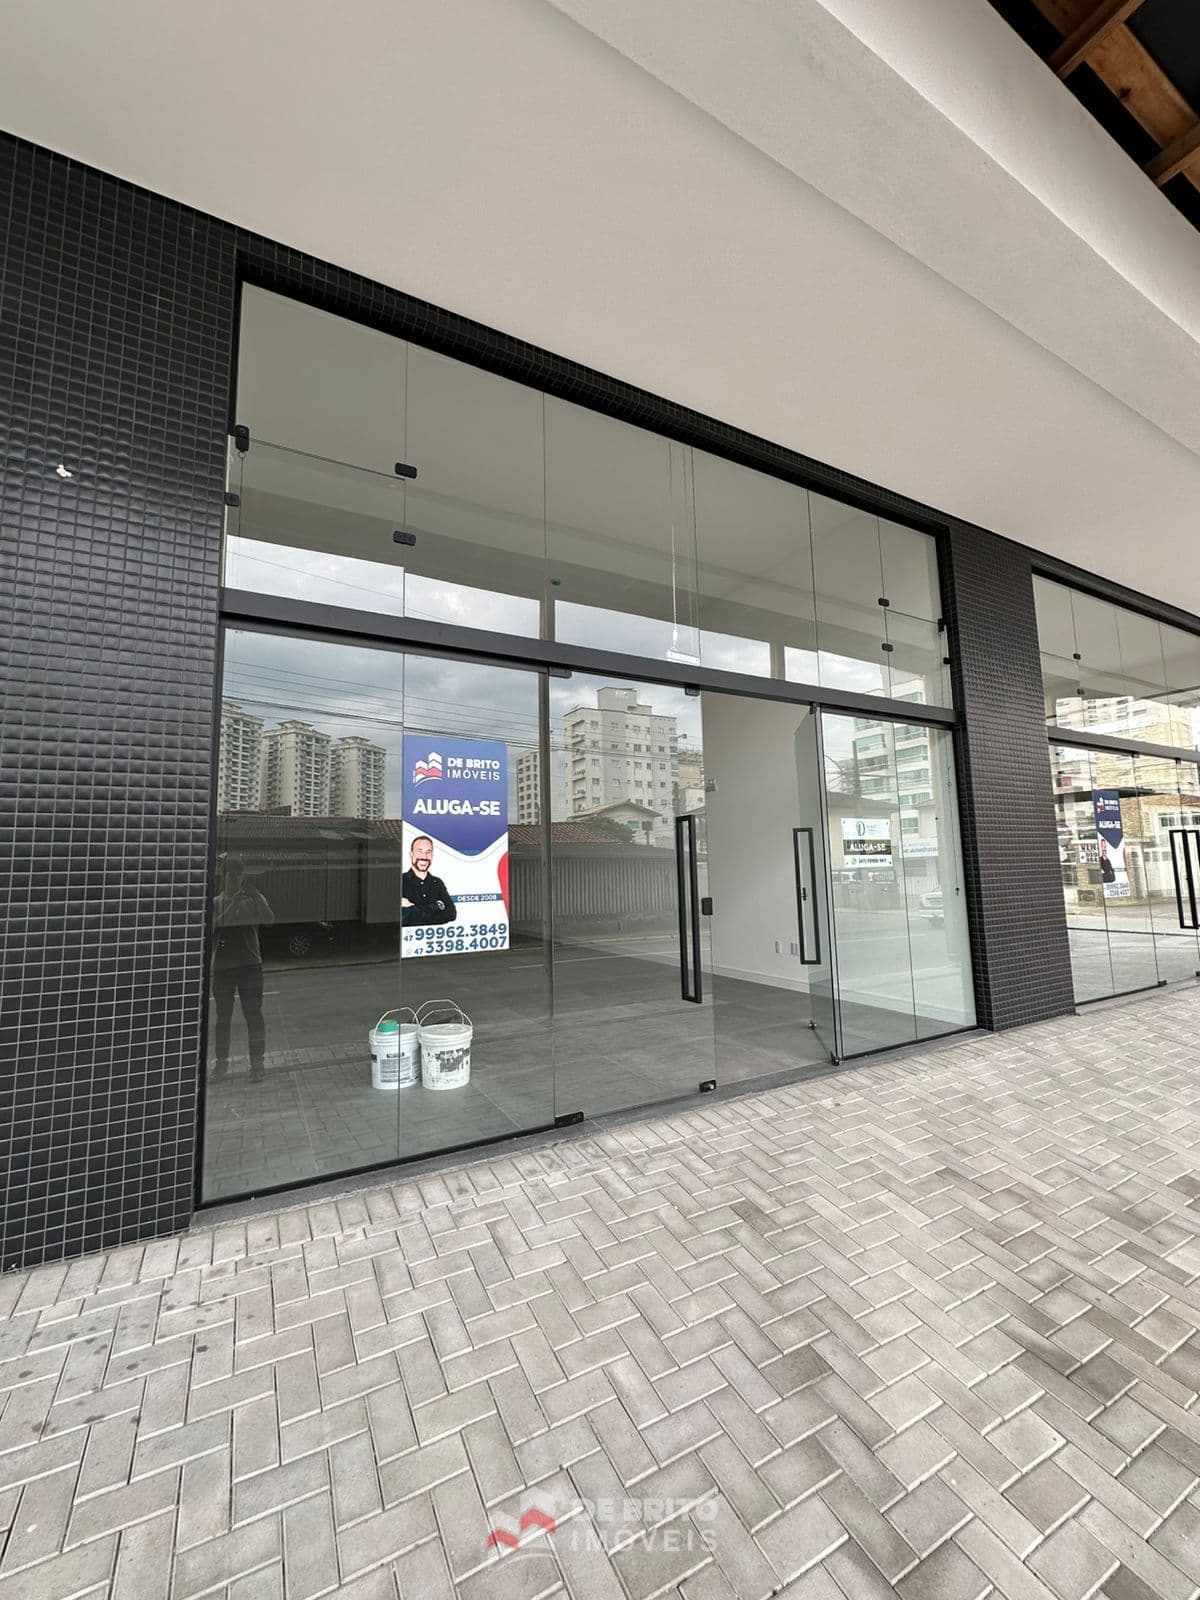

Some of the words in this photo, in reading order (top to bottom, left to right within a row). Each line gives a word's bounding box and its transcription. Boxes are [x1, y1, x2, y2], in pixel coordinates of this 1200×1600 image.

[447, 757, 465, 768] DE
[466, 758, 500, 770] BRITO
[447, 768, 500, 781] IMÓVEIS
[413, 799, 501, 816] ALUGA-SE
[849, 843, 886, 852] ALUGA-SE
[457, 894, 480, 902] DESDE
[481, 893, 497, 901] 2008
[403, 934, 413, 942] 47
[415, 923, 507, 941] 99962.3849
[413, 947, 424, 955] 47
[425, 936, 507, 954] 3398.4007
